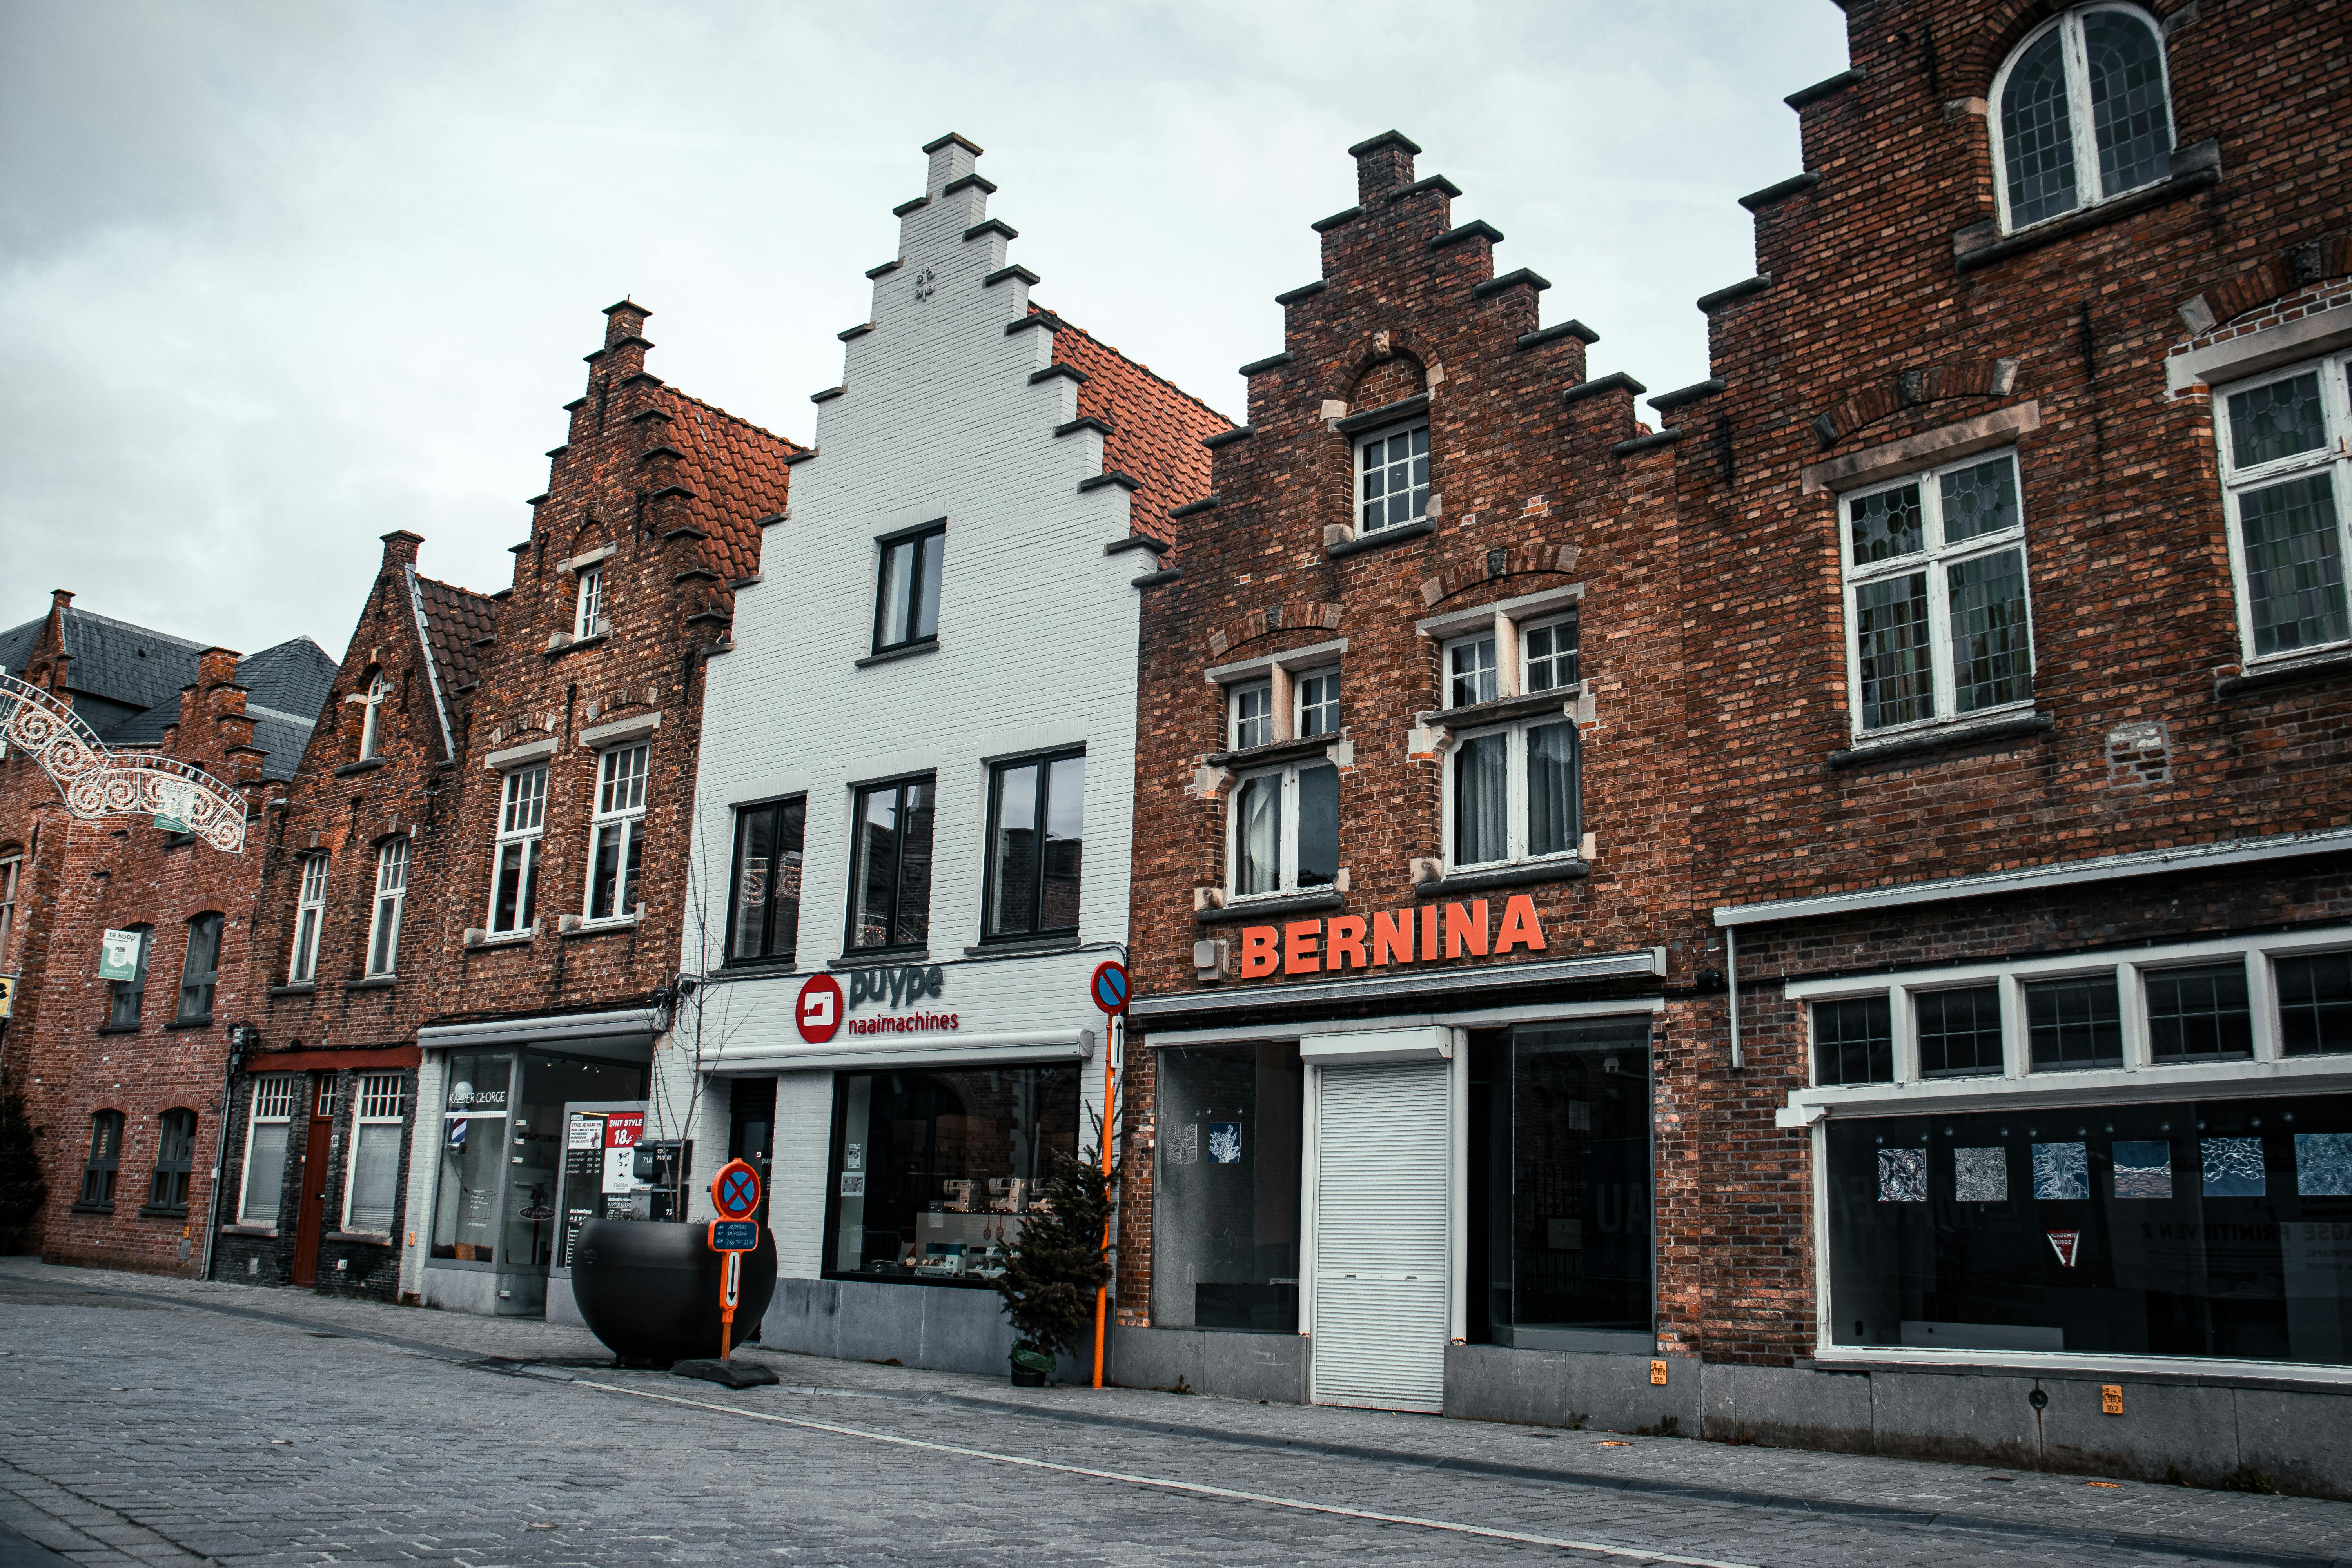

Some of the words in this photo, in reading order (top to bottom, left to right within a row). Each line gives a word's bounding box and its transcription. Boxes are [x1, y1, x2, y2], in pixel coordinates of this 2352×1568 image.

[118, 932, 136, 942] koop
[1241, 894, 1546, 978] BERNINA
[849, 965, 943, 1011] puype
[849, 1011, 959, 1034] naaimachines
[449, 1093, 475, 1104] KAPPER
[476, 1091, 505, 1103] GEORGE
[624, 1118, 643, 1127] STYLE
